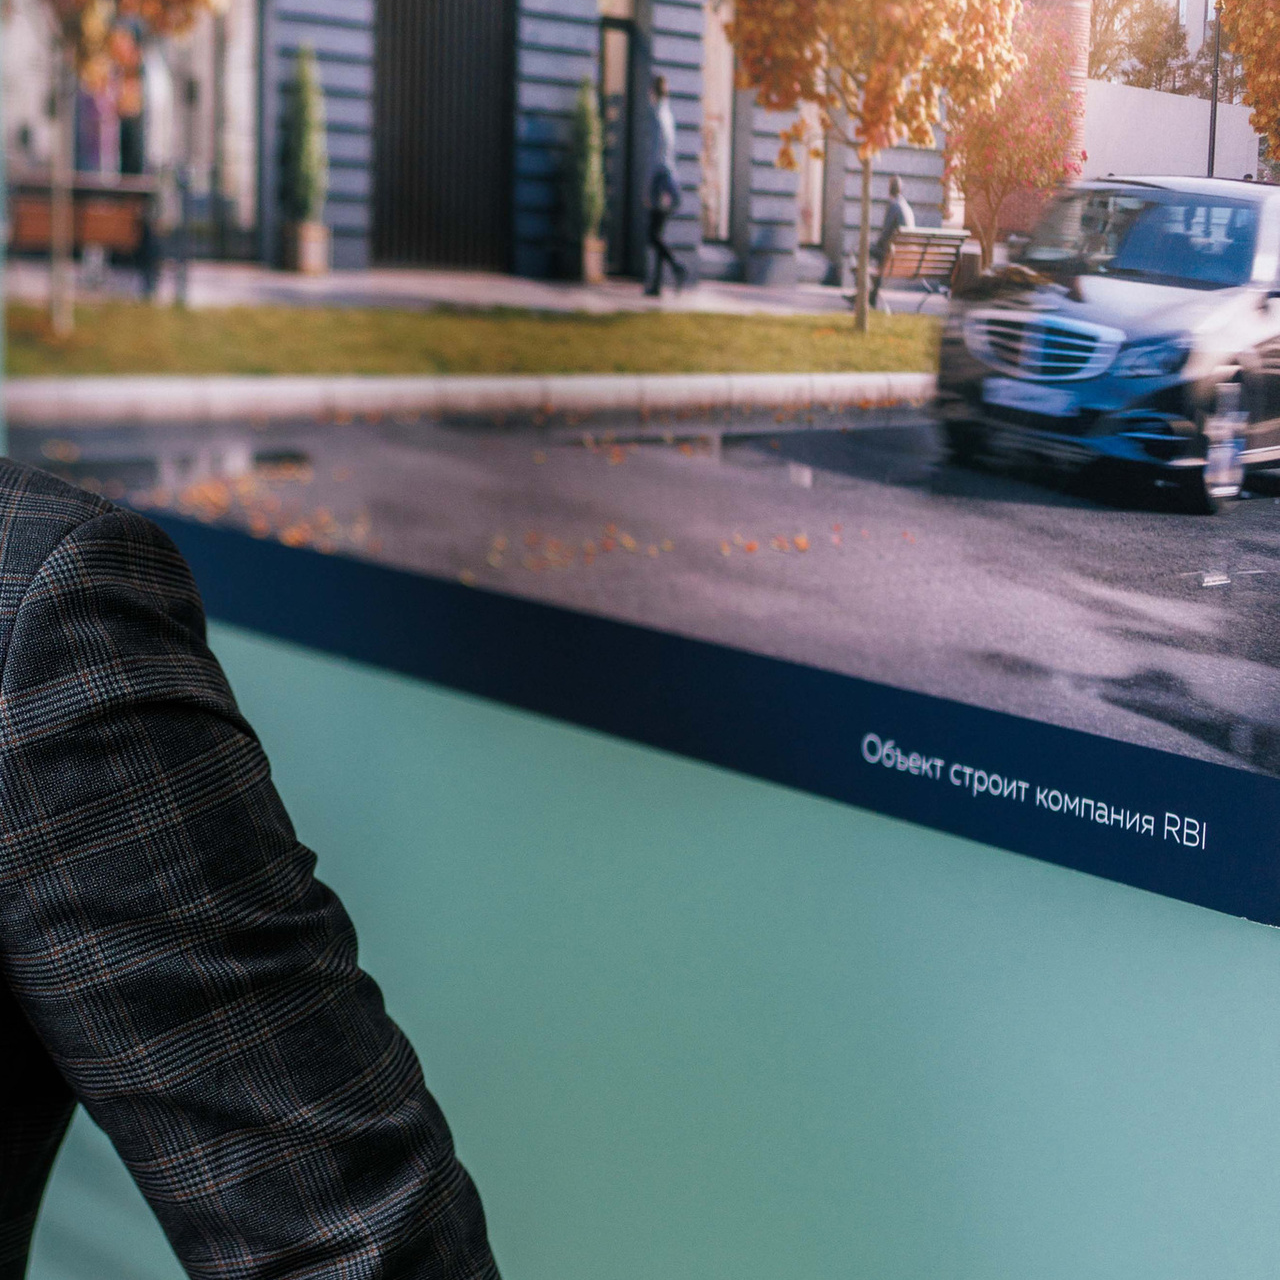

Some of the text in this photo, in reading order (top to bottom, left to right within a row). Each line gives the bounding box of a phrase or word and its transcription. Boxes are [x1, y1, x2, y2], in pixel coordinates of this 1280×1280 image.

[861, 732, 1207, 850] Объект строит компания RBI
